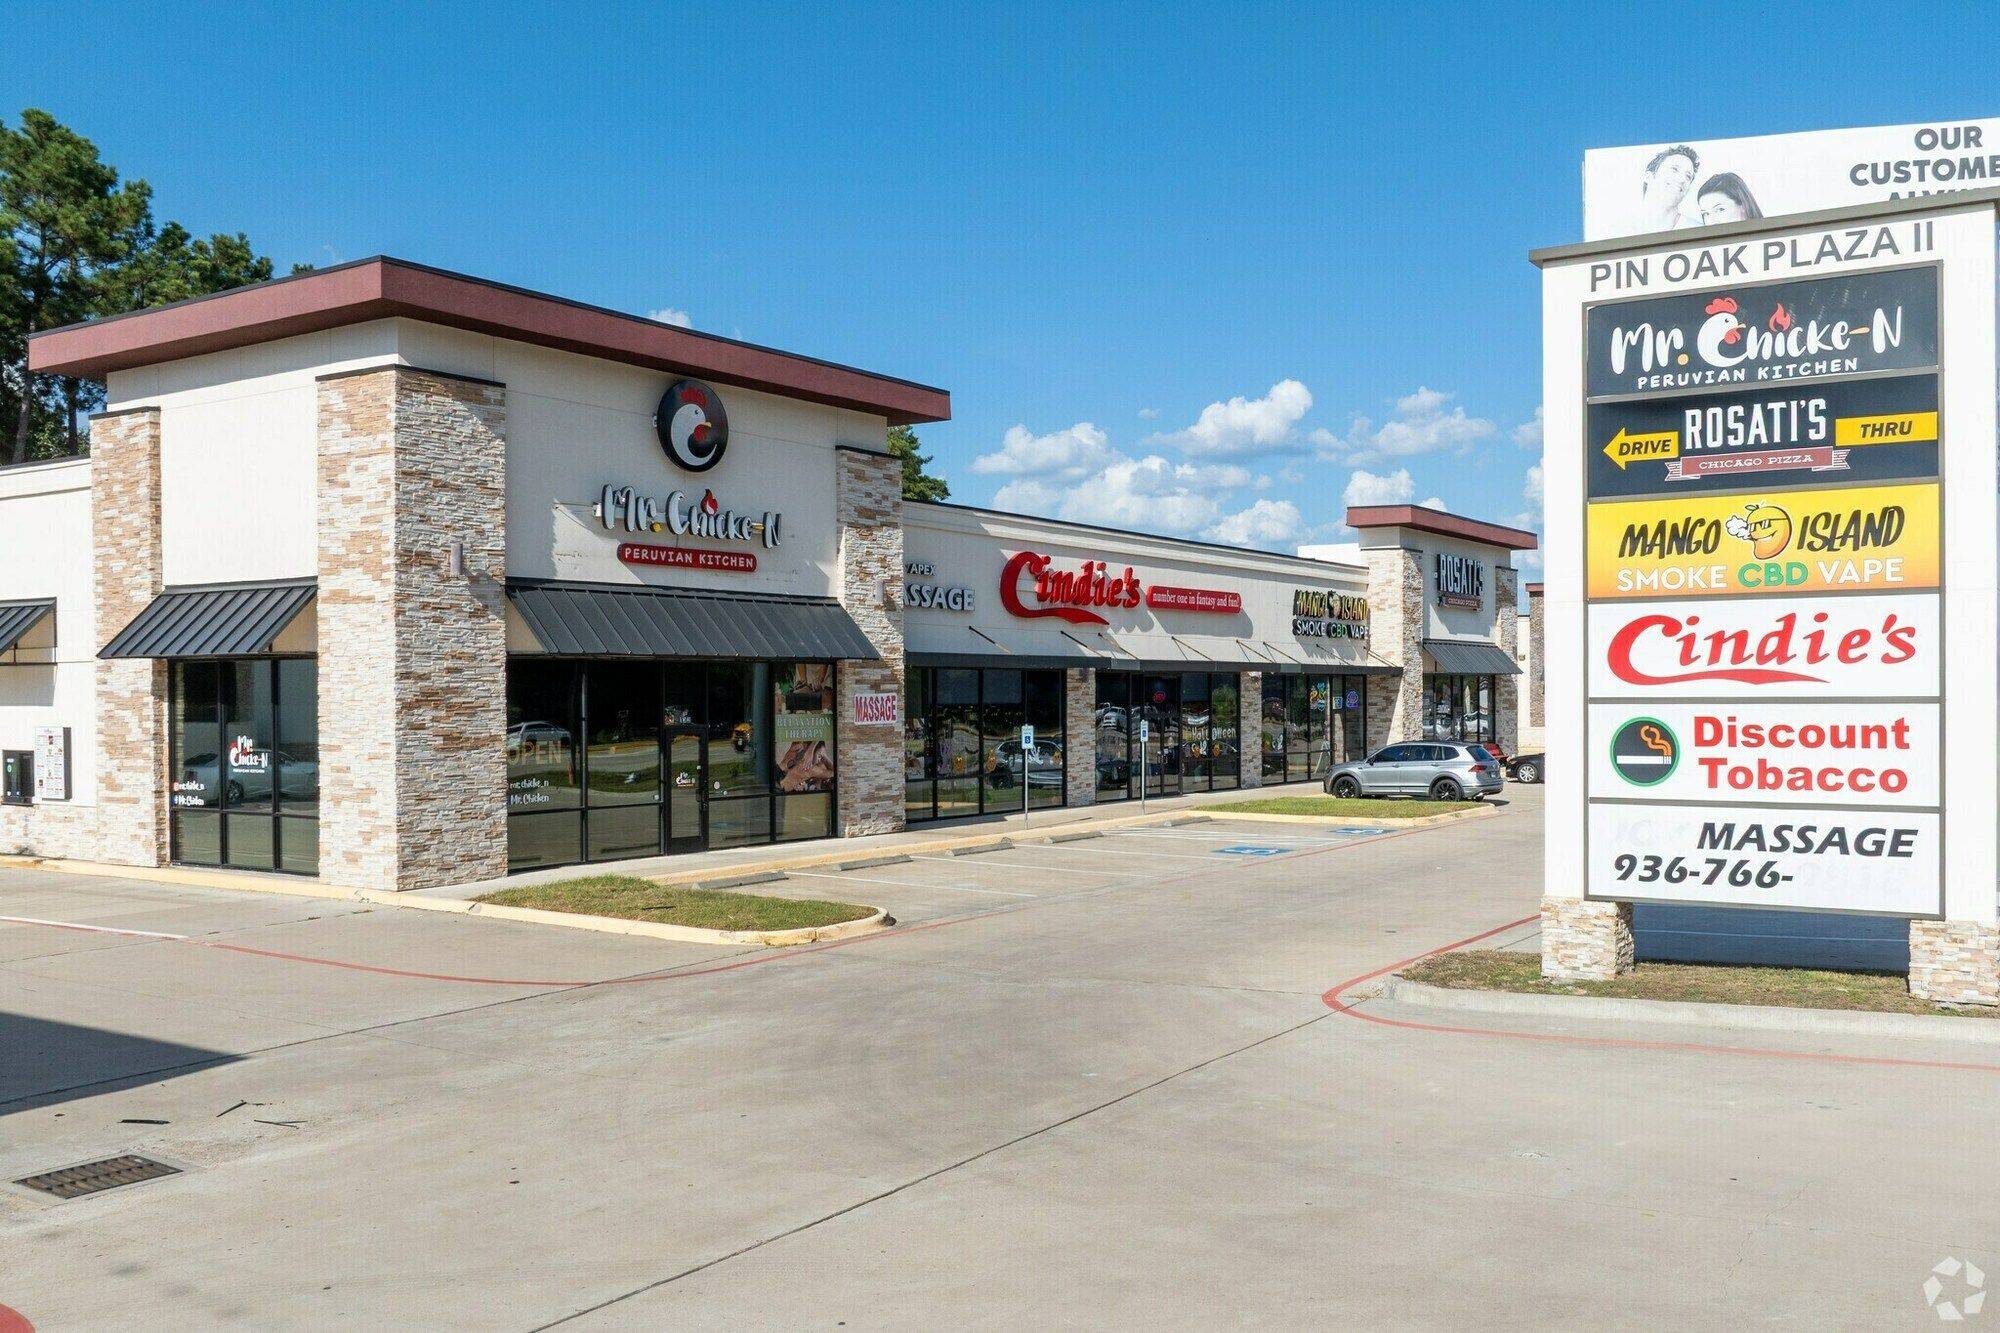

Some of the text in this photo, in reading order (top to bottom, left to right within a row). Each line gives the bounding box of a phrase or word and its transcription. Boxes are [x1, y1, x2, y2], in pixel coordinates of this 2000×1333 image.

[1914, 126, 1983, 151] OUR
[1590, 221, 1934, 292] PIN OAK PLAZA II
[1637, 357, 1859, 390] PERUVIAN KITCHEN
[1684, 397, 1828, 450] ROSATI'S
[1860, 420, 1913, 439] THRU
[1618, 438, 1671, 457] DRIVE
[1698, 453, 1814, 470] CHICAGO PIZZA
[1618, 505, 1906, 560] MANGO ISLAND
[624, 547, 754, 568] PERUVIAN KITCHEN
[1616, 557, 1905, 592] SMOKE CBD VAPE
[902, 583, 976, 611] ASSAGE
[1000, 551, 1141, 625] Cindie's
[1294, 619, 1369, 639] SMOKE CBD VAPE
[1607, 612, 1917, 686] Cindie's
[854, 695, 897, 722] MASSAGE
[1693, 716, 1911, 750] Discount
[1698, 757, 1909, 794] Tobacco
[1696, 822, 1919, 858] MASSAGE
[1613, 853, 1794, 889] 936-766-
